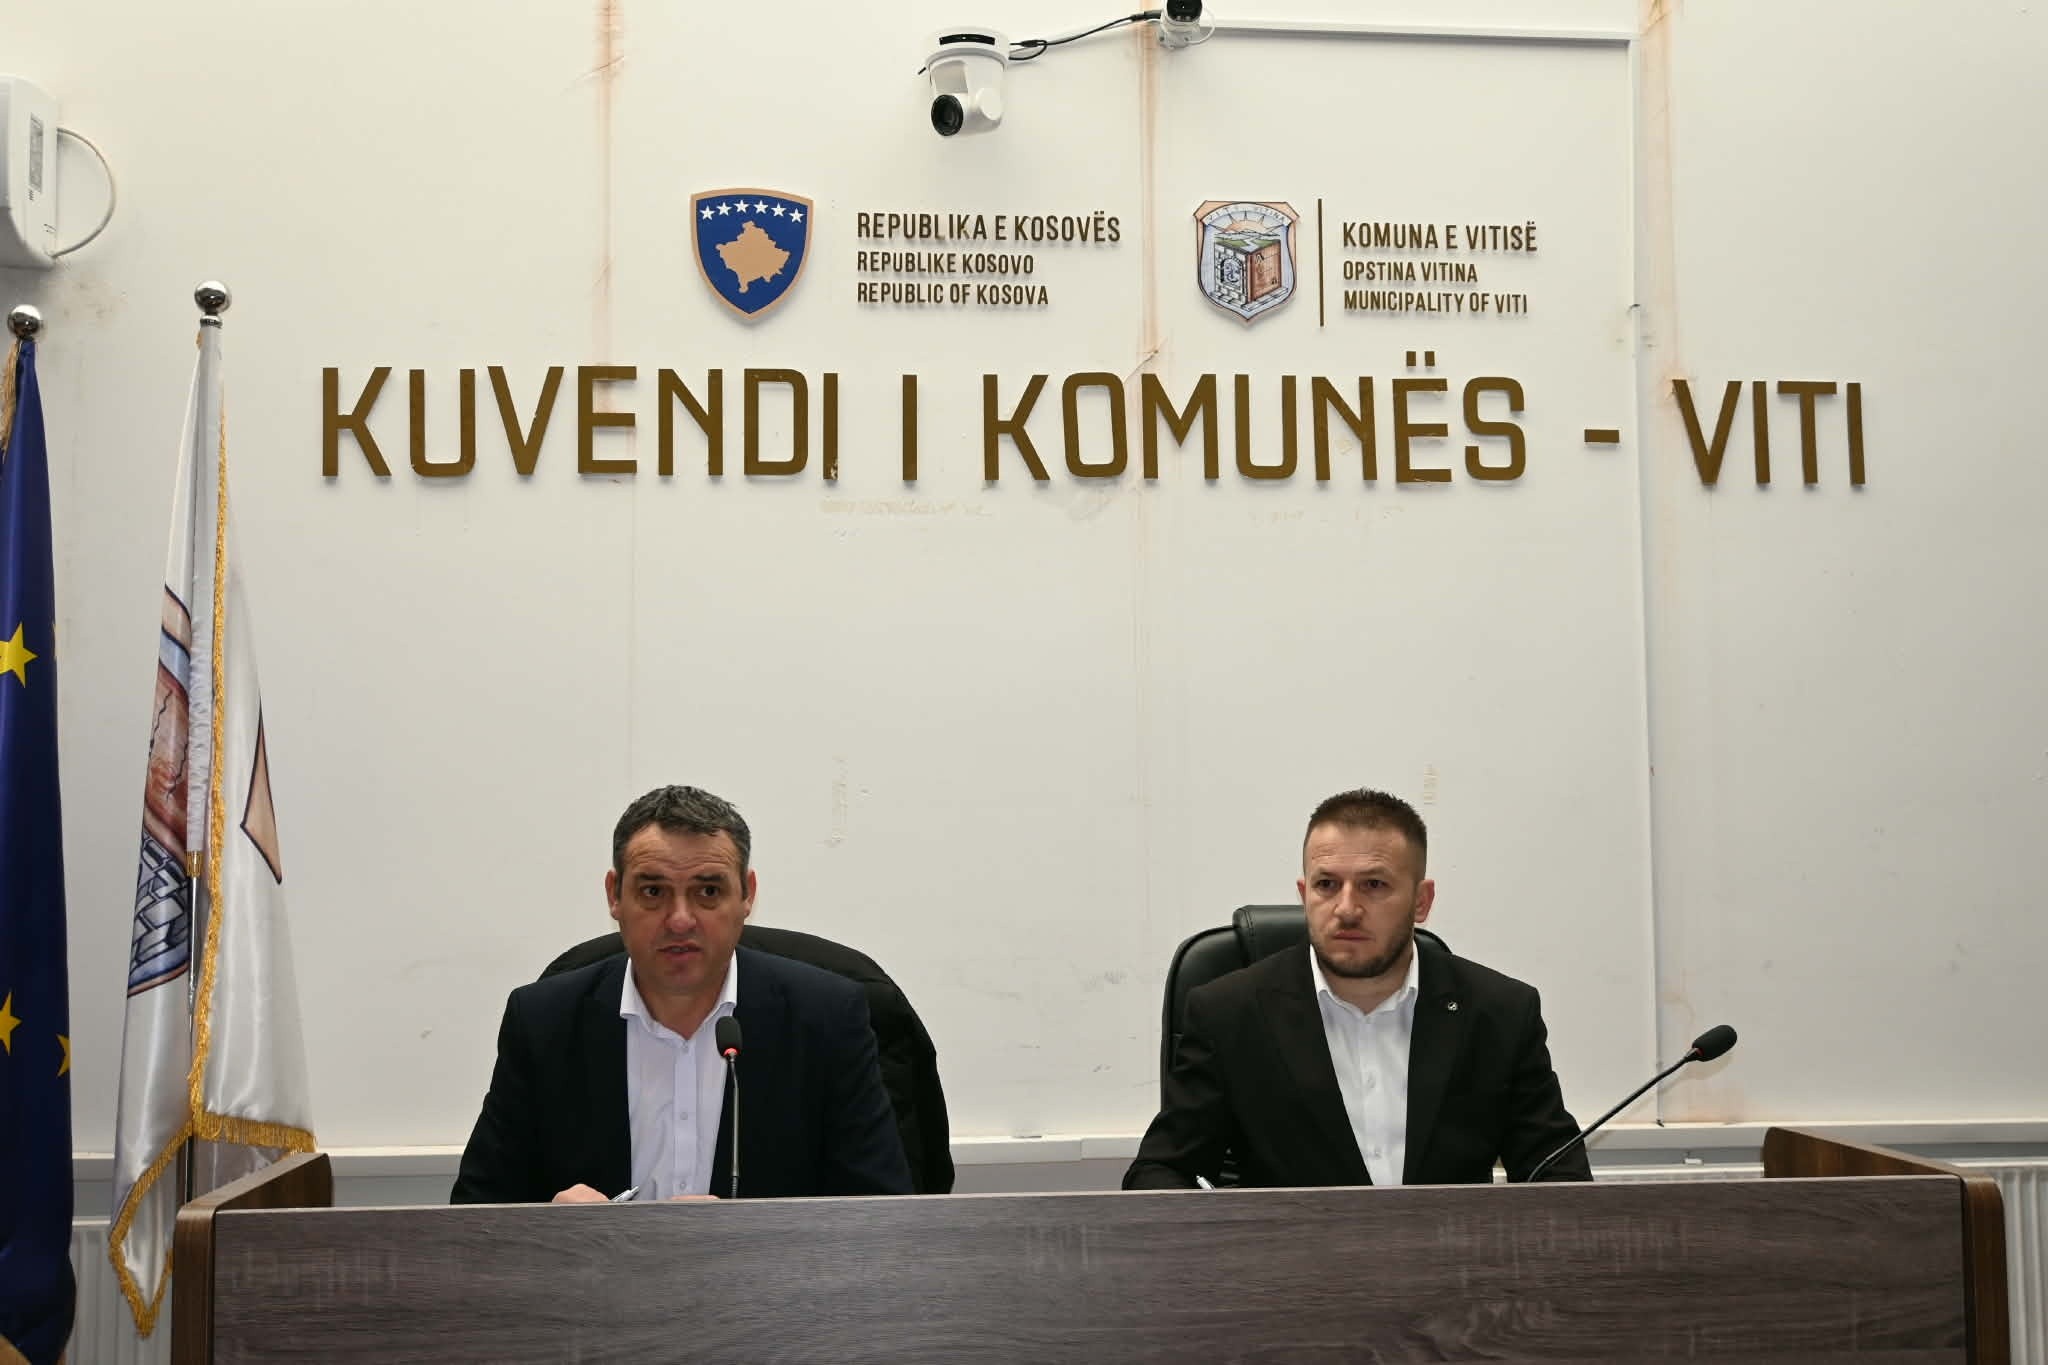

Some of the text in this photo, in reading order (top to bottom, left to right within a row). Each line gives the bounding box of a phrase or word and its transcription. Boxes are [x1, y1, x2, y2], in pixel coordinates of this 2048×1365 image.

[857, 210, 1121, 243] REPUBLIKA E KOSOVËS
[1343, 220, 1538, 252] KOMUNA E VITISË
[857, 251, 1034, 275] REPUBLIKE KOSOVO
[1343, 260, 1478, 283] OPSTINA VITINA
[857, 282, 1049, 305] REPUBLIC OF KOSOVA
[1344, 290, 1528, 314] MUNICIPALITY OF VITI
[322, 350, 1866, 485] KUVENDI I KOMUNËS - VITI
